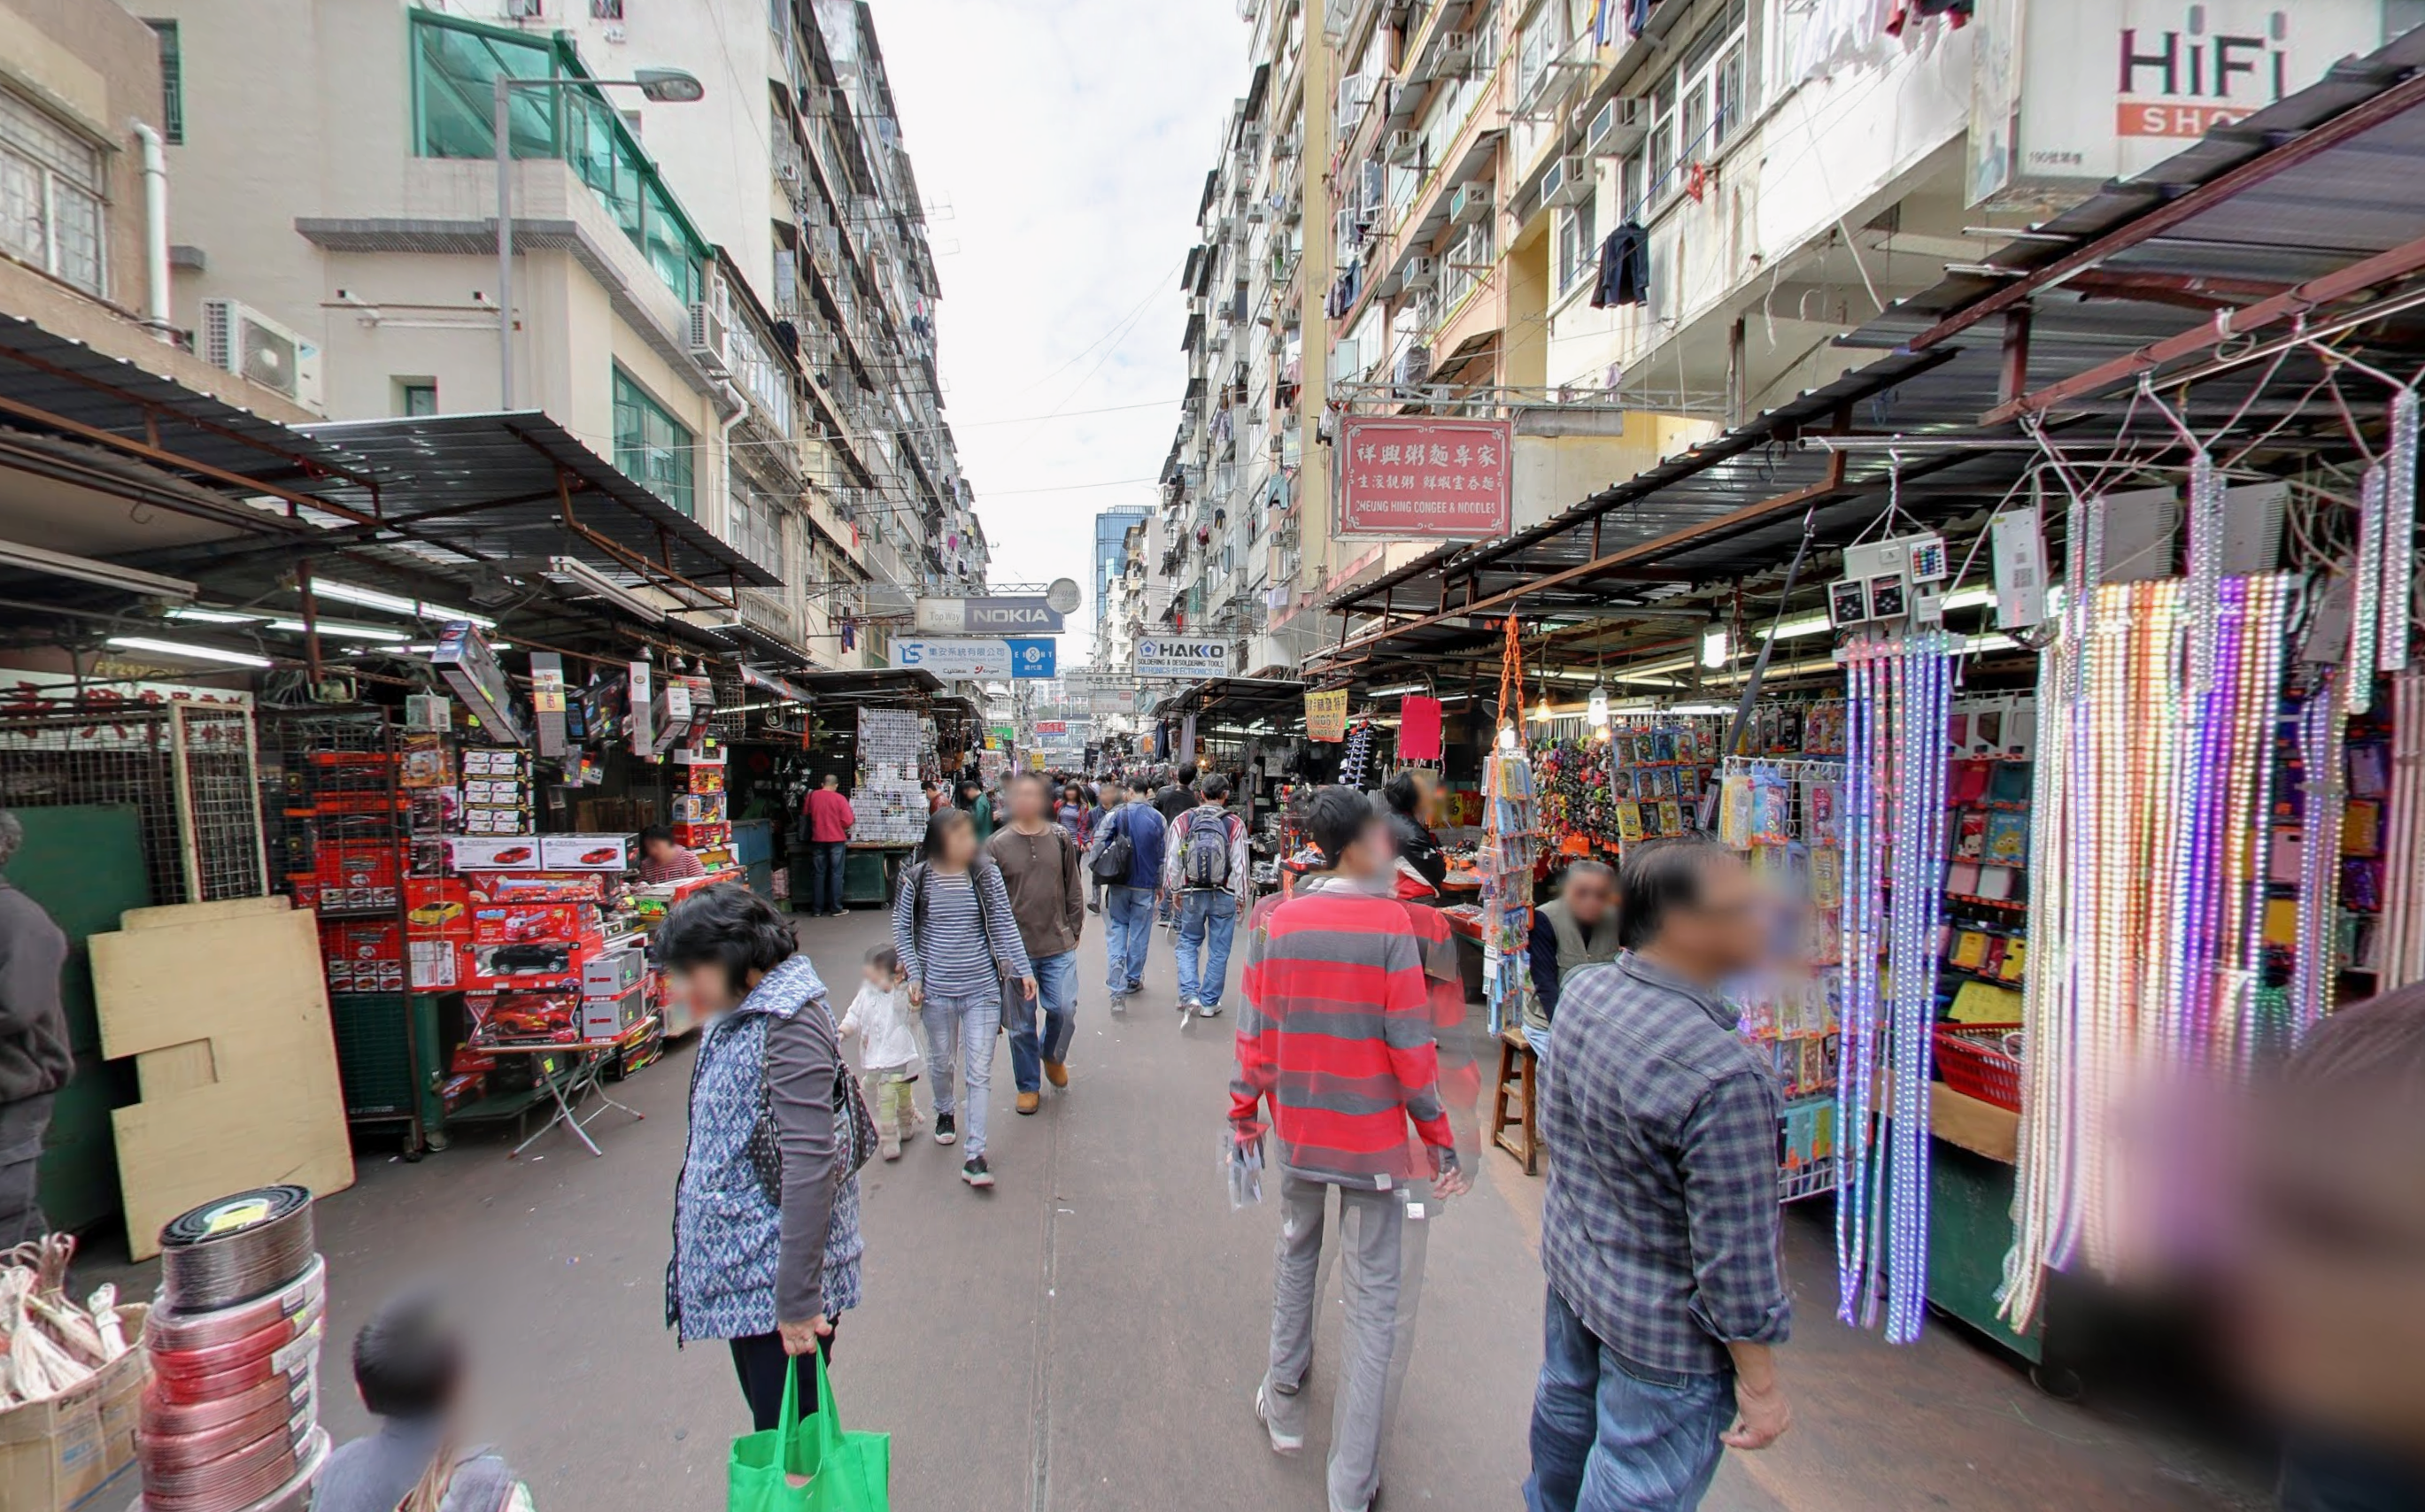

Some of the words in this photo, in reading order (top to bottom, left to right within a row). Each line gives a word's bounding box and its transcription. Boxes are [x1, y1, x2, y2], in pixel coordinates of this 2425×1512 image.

[2118, 4, 2287, 101] HiFi
[2143, 106, 2254, 134] SHO
[1356, 444, 1497, 467] 祥興粥麵專家
[1357, 474, 1415, 489] 生滾靚粥
[1423, 475, 1494, 491] 鮮蝦雲吞麵
[1355, 500, 1388, 513] CHEUNG
[1391, 500, 1411, 513] HING
[1414, 501, 1447, 513] CONGEE
[1449, 502, 1455, 513] &
[1457, 502, 1495, 514] NOODLES
[929, 612, 944, 622] Top
[945, 612, 961, 623] Way
[974, 608, 1049, 622] NOKIA
[929, 647, 1005, 657] 集安系統有限公司
[1160, 644, 1224, 658] HAKKO
